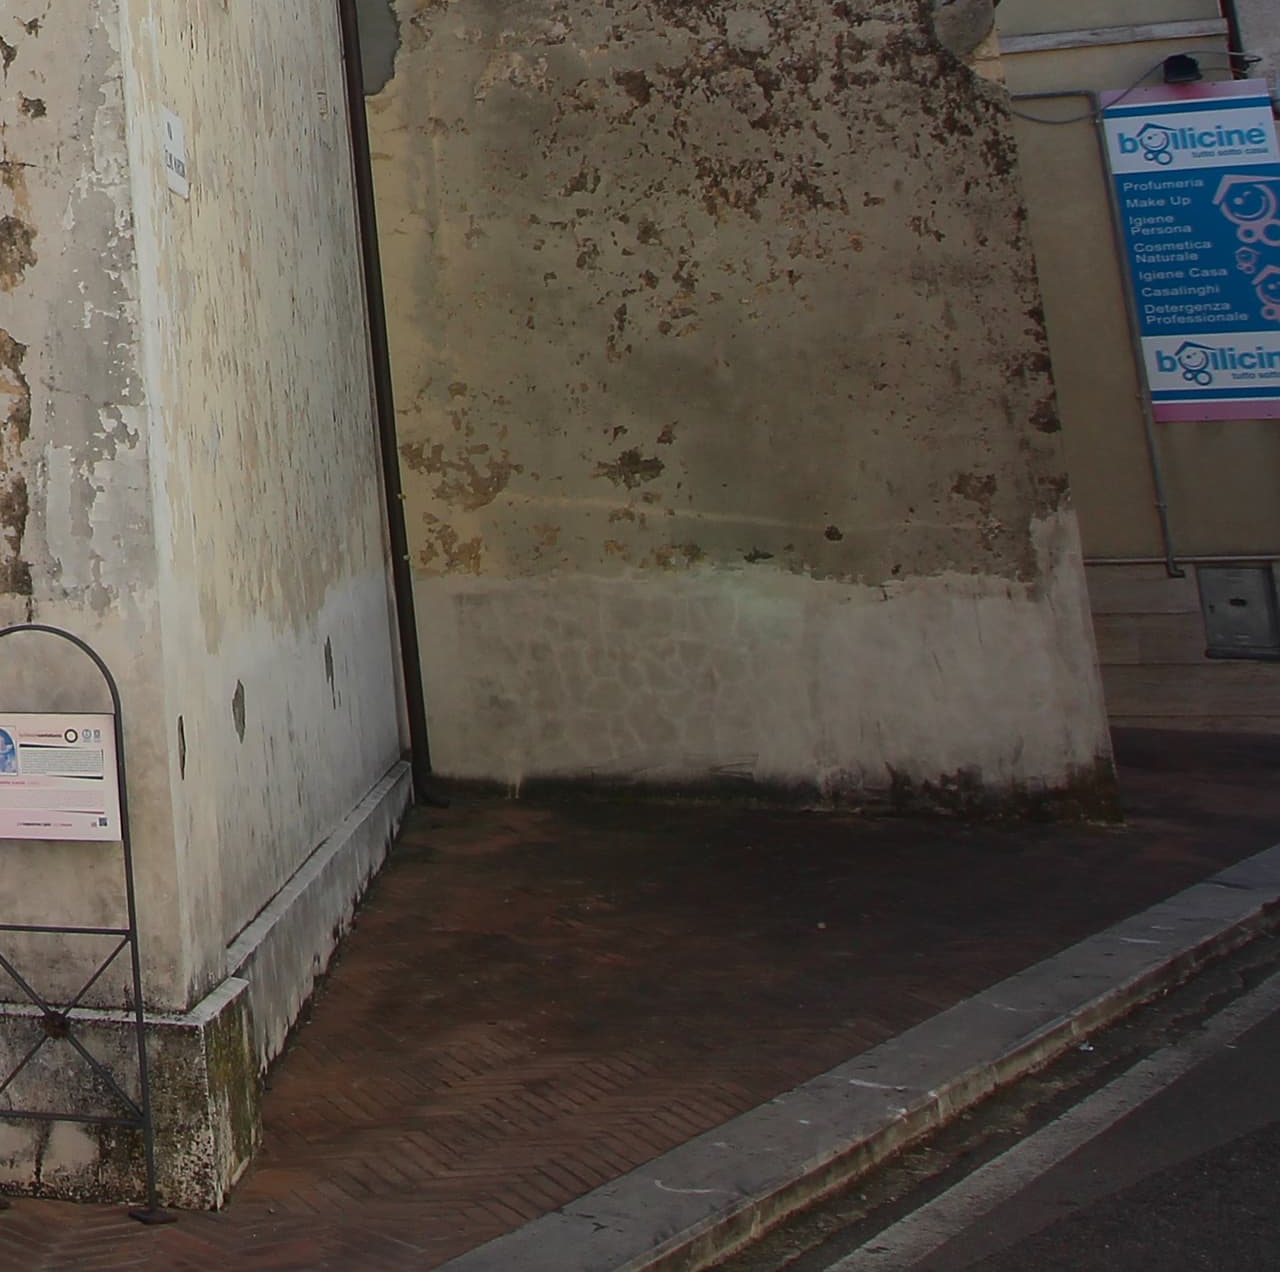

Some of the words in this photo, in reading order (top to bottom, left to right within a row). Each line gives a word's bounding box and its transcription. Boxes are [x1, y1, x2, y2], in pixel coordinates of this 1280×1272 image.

[1117, 124, 1267, 155] bollicine
[1123, 178, 1204, 192] Profumeria
[1126, 198, 1166, 209] Make
[1170, 196, 1192, 207] Up
[1129, 214, 1175, 227] Igiene
[1130, 224, 1193, 236] Persona
[1133, 240, 1212, 253] Cosmetica
[1135, 251, 1199, 264] Naturale
[1138, 269, 1185, 282] Igiene
[1188, 267, 1229, 278] Casa
[1141, 284, 1220, 298] Casalinghi
[1144, 301, 1232, 315] Detergenza
[1146, 311, 1249, 326] Professionale
